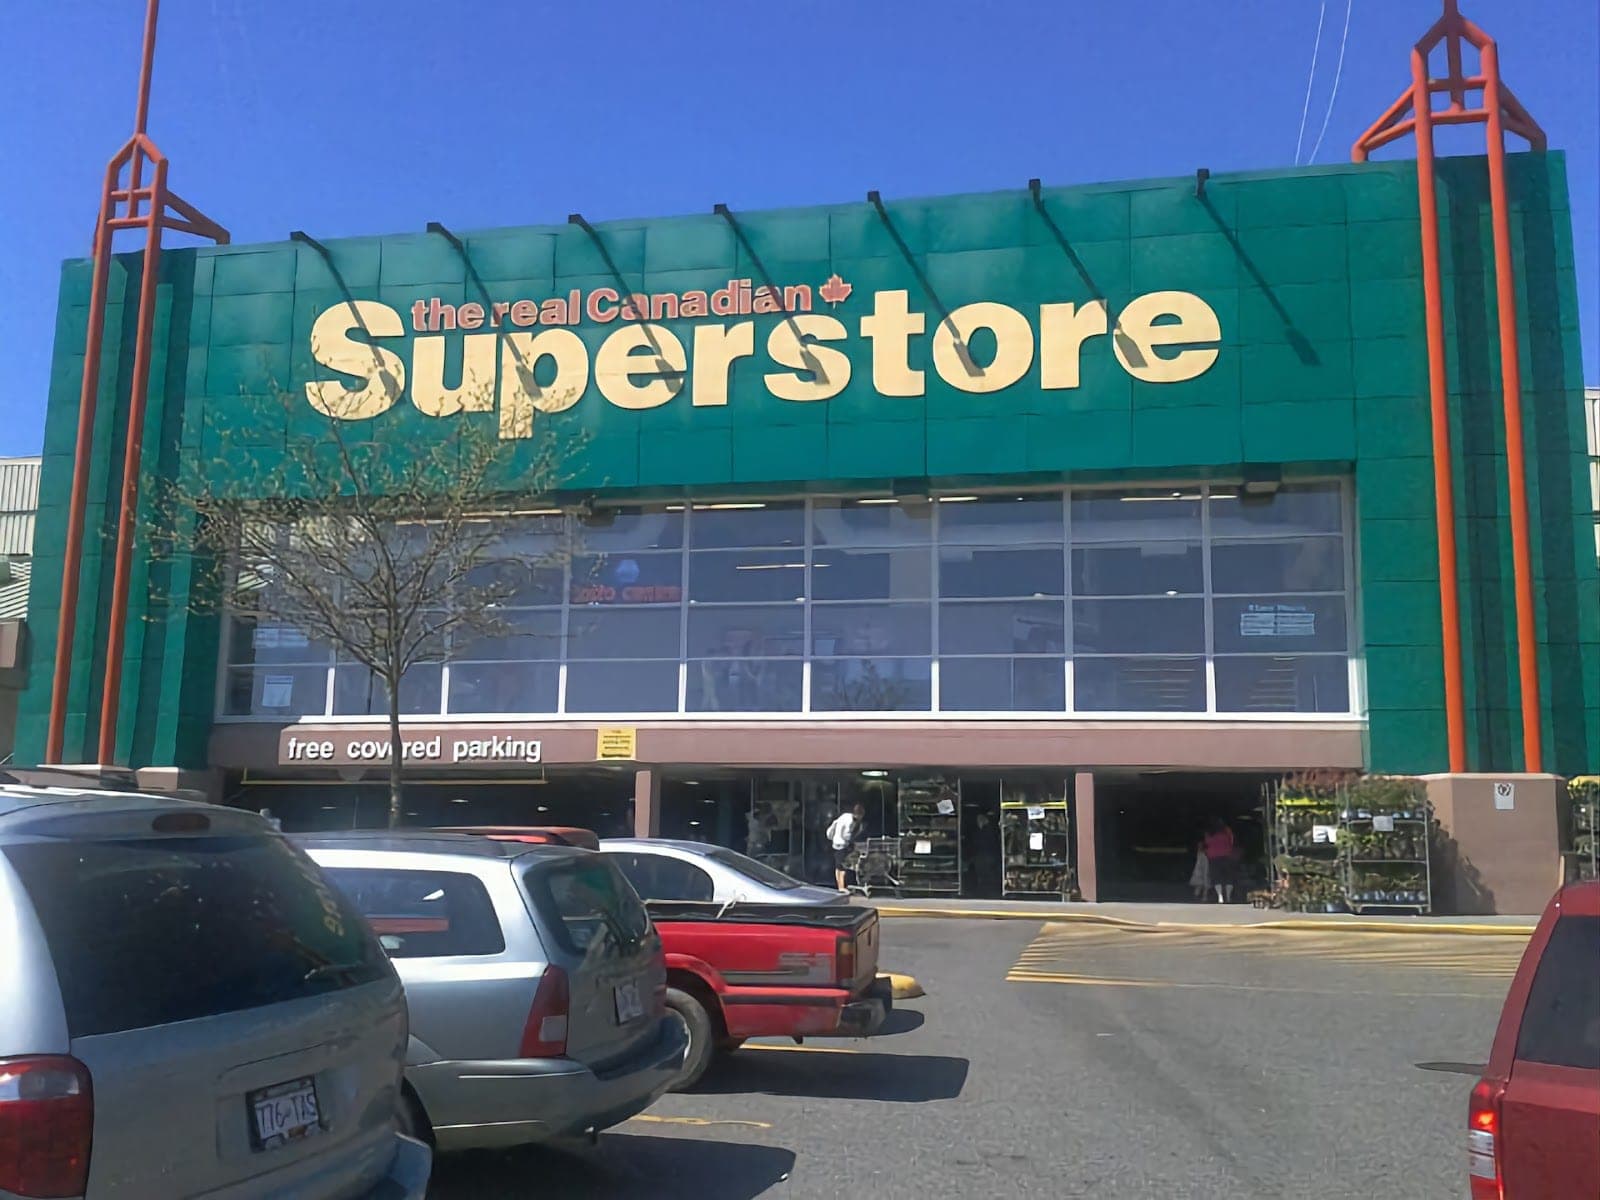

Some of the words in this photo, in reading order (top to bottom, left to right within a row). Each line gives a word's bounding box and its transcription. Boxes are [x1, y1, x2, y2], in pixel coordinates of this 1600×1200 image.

[412, 298, 485, 331] the
[489, 289, 581, 328] real
[587, 279, 812, 322] Canadian
[305, 289, 1222, 439] Superstore
[288, 738, 333, 759] free
[347, 736, 441, 759] covred
[453, 736, 541, 762] parking
